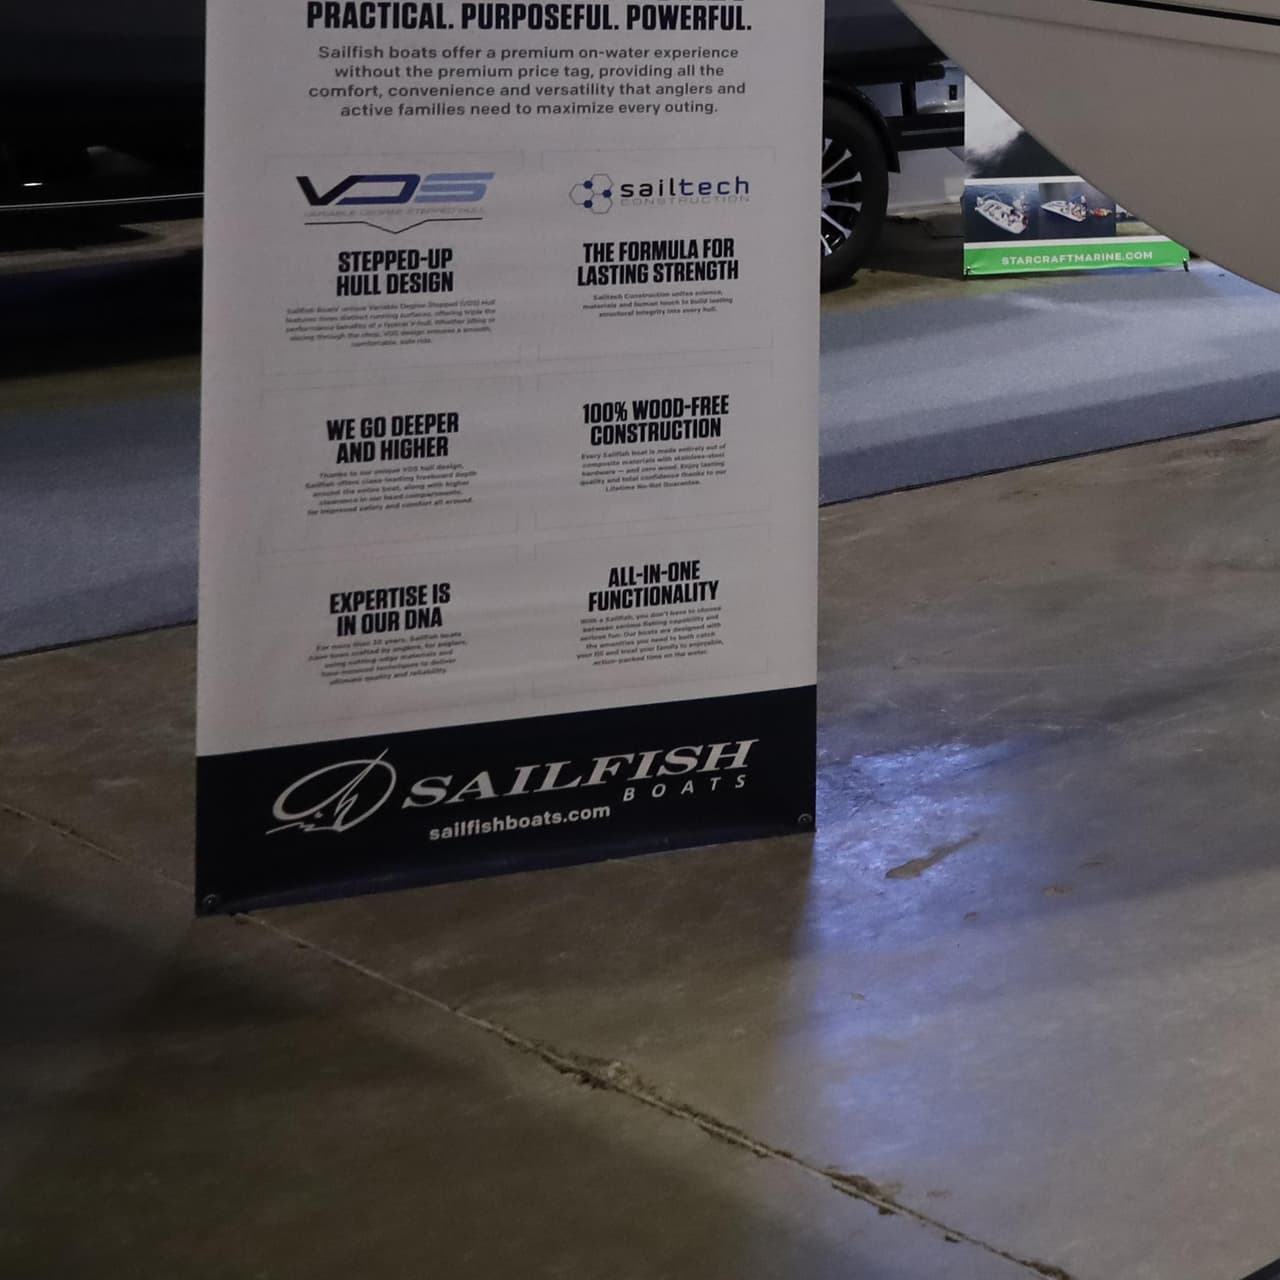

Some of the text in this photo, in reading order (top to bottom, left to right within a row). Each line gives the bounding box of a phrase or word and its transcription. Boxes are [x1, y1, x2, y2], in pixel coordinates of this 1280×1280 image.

[307, 1, 751, 30] PRACTICAL. PURPOSEFUL. POWERFUL.
[319, 46, 738, 61] Sailfish boats offer a premium on-water experience
[335, 64, 724, 80] without the premium price tag, providing all the
[309, 82, 745, 99] comfort, convenience and versatility that anglers and
[341, 101, 717, 116] active families need to maximize every outing.
[296, 172, 495, 206] VDS
[621, 176, 748, 197] sailtech
[620, 195, 750, 208] CONSTRUCTION
[338, 248, 453, 274] STEPPED-UP
[583, 238, 734, 263] THE FORMULA FOR
[1001, 251, 1153, 266] STARCRAFTMARINE.COM
[337, 270, 453, 296] HULL DESIGN
[578, 258, 738, 286] LASTING STRENGTH
[583, 395, 729, 424] 100% WOOD-FREE
[327, 412, 458, 440] WE GO DEEPER
[591, 418, 721, 446] CONSTRUCTION
[336, 436, 448, 464] AND HIGHER
[608, 560, 701, 588] ALL-IN-ONE
[330, 583, 450, 614] EXPERTISE IS
[589, 580, 720, 612] FUNCTIONALITY
[337, 607, 442, 636] IN OUR DNA
[402, 738, 759, 809] SAILFISH
[622, 774, 747, 802] BOATS
[429, 803, 611, 841] sailfishboats.com
